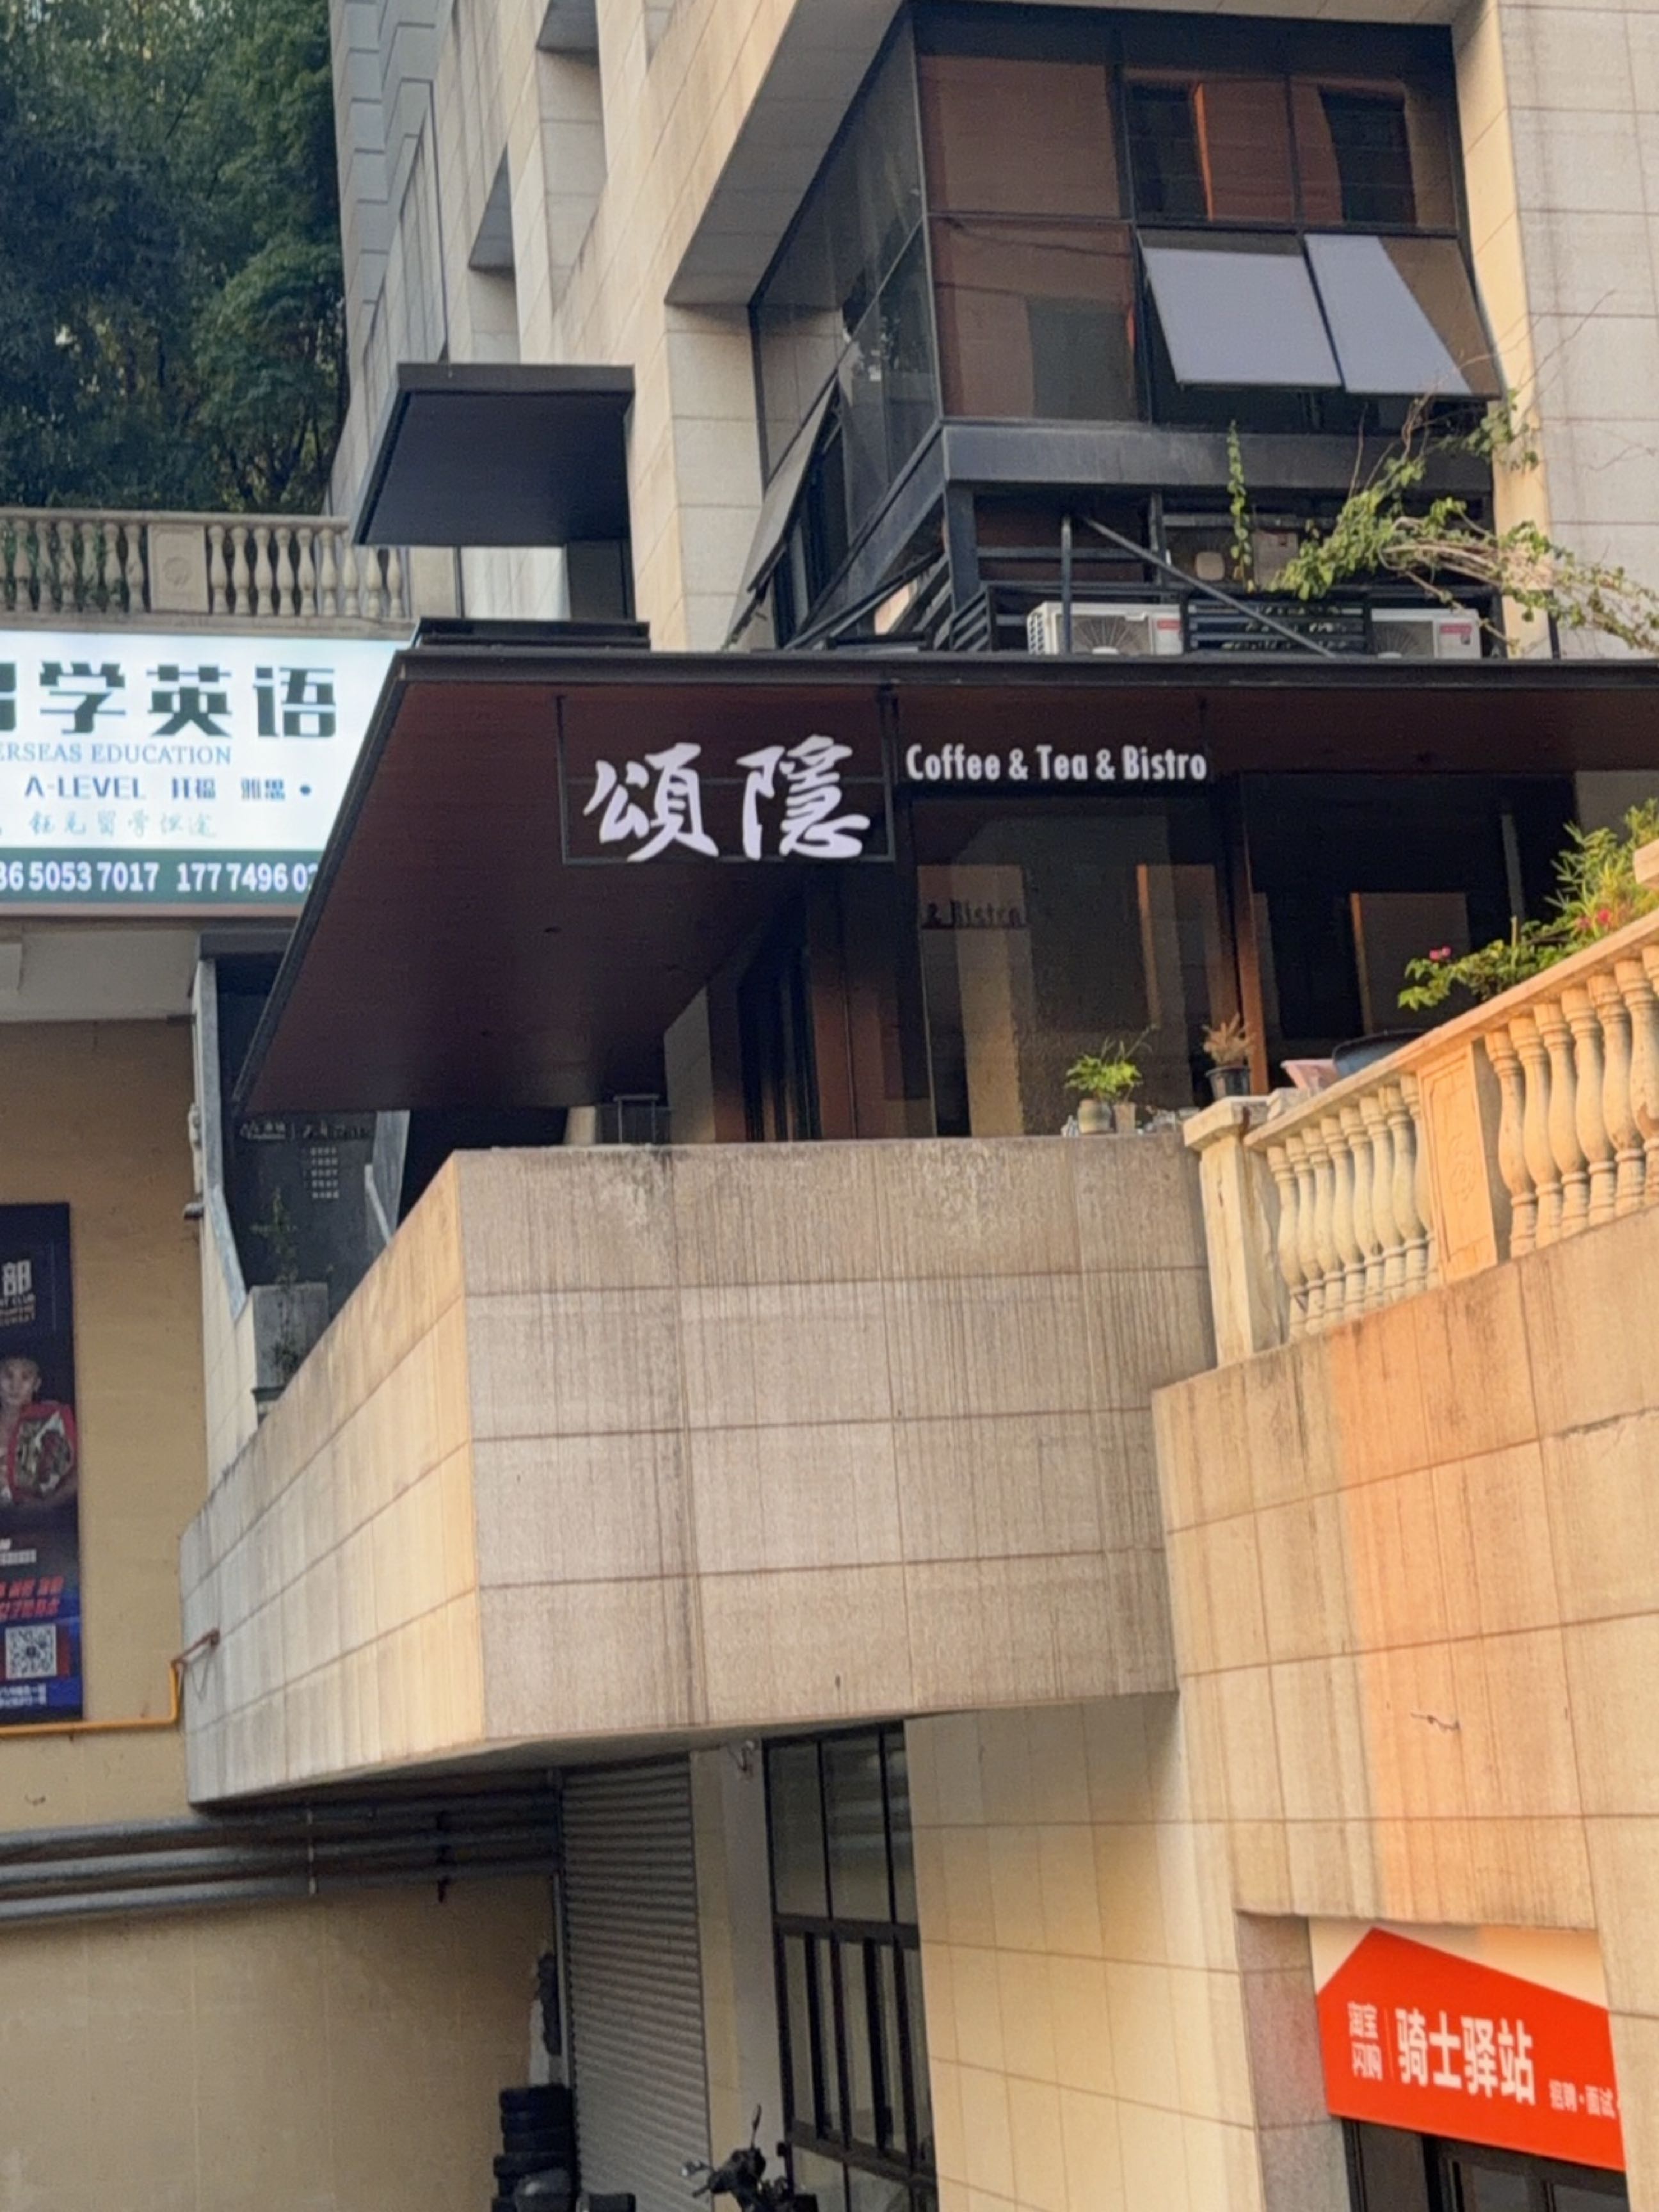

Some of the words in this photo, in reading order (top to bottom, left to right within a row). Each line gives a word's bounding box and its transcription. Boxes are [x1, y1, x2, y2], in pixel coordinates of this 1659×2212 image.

[0, 661, 337, 738] 学英语
[0, 742, 82, 762] RSEAS
[91, 744, 232, 765] EDUCATION
[906, 744, 1000, 780] Coffee
[1009, 748, 1029, 780] &
[1036, 745, 1088, 780] Tea
[1096, 749, 1116, 780] &
[1123, 745, 1207, 780] Bistro
[24, 776, 146, 799] A-LEVEL
[29, 861, 92, 891] 5053
[97, 862, 158, 892] 7017
[176, 862, 221, 892] 177
[226, 863, 288, 892] 7496
[1395, 2007, 1535, 2106] 骑士驿站
